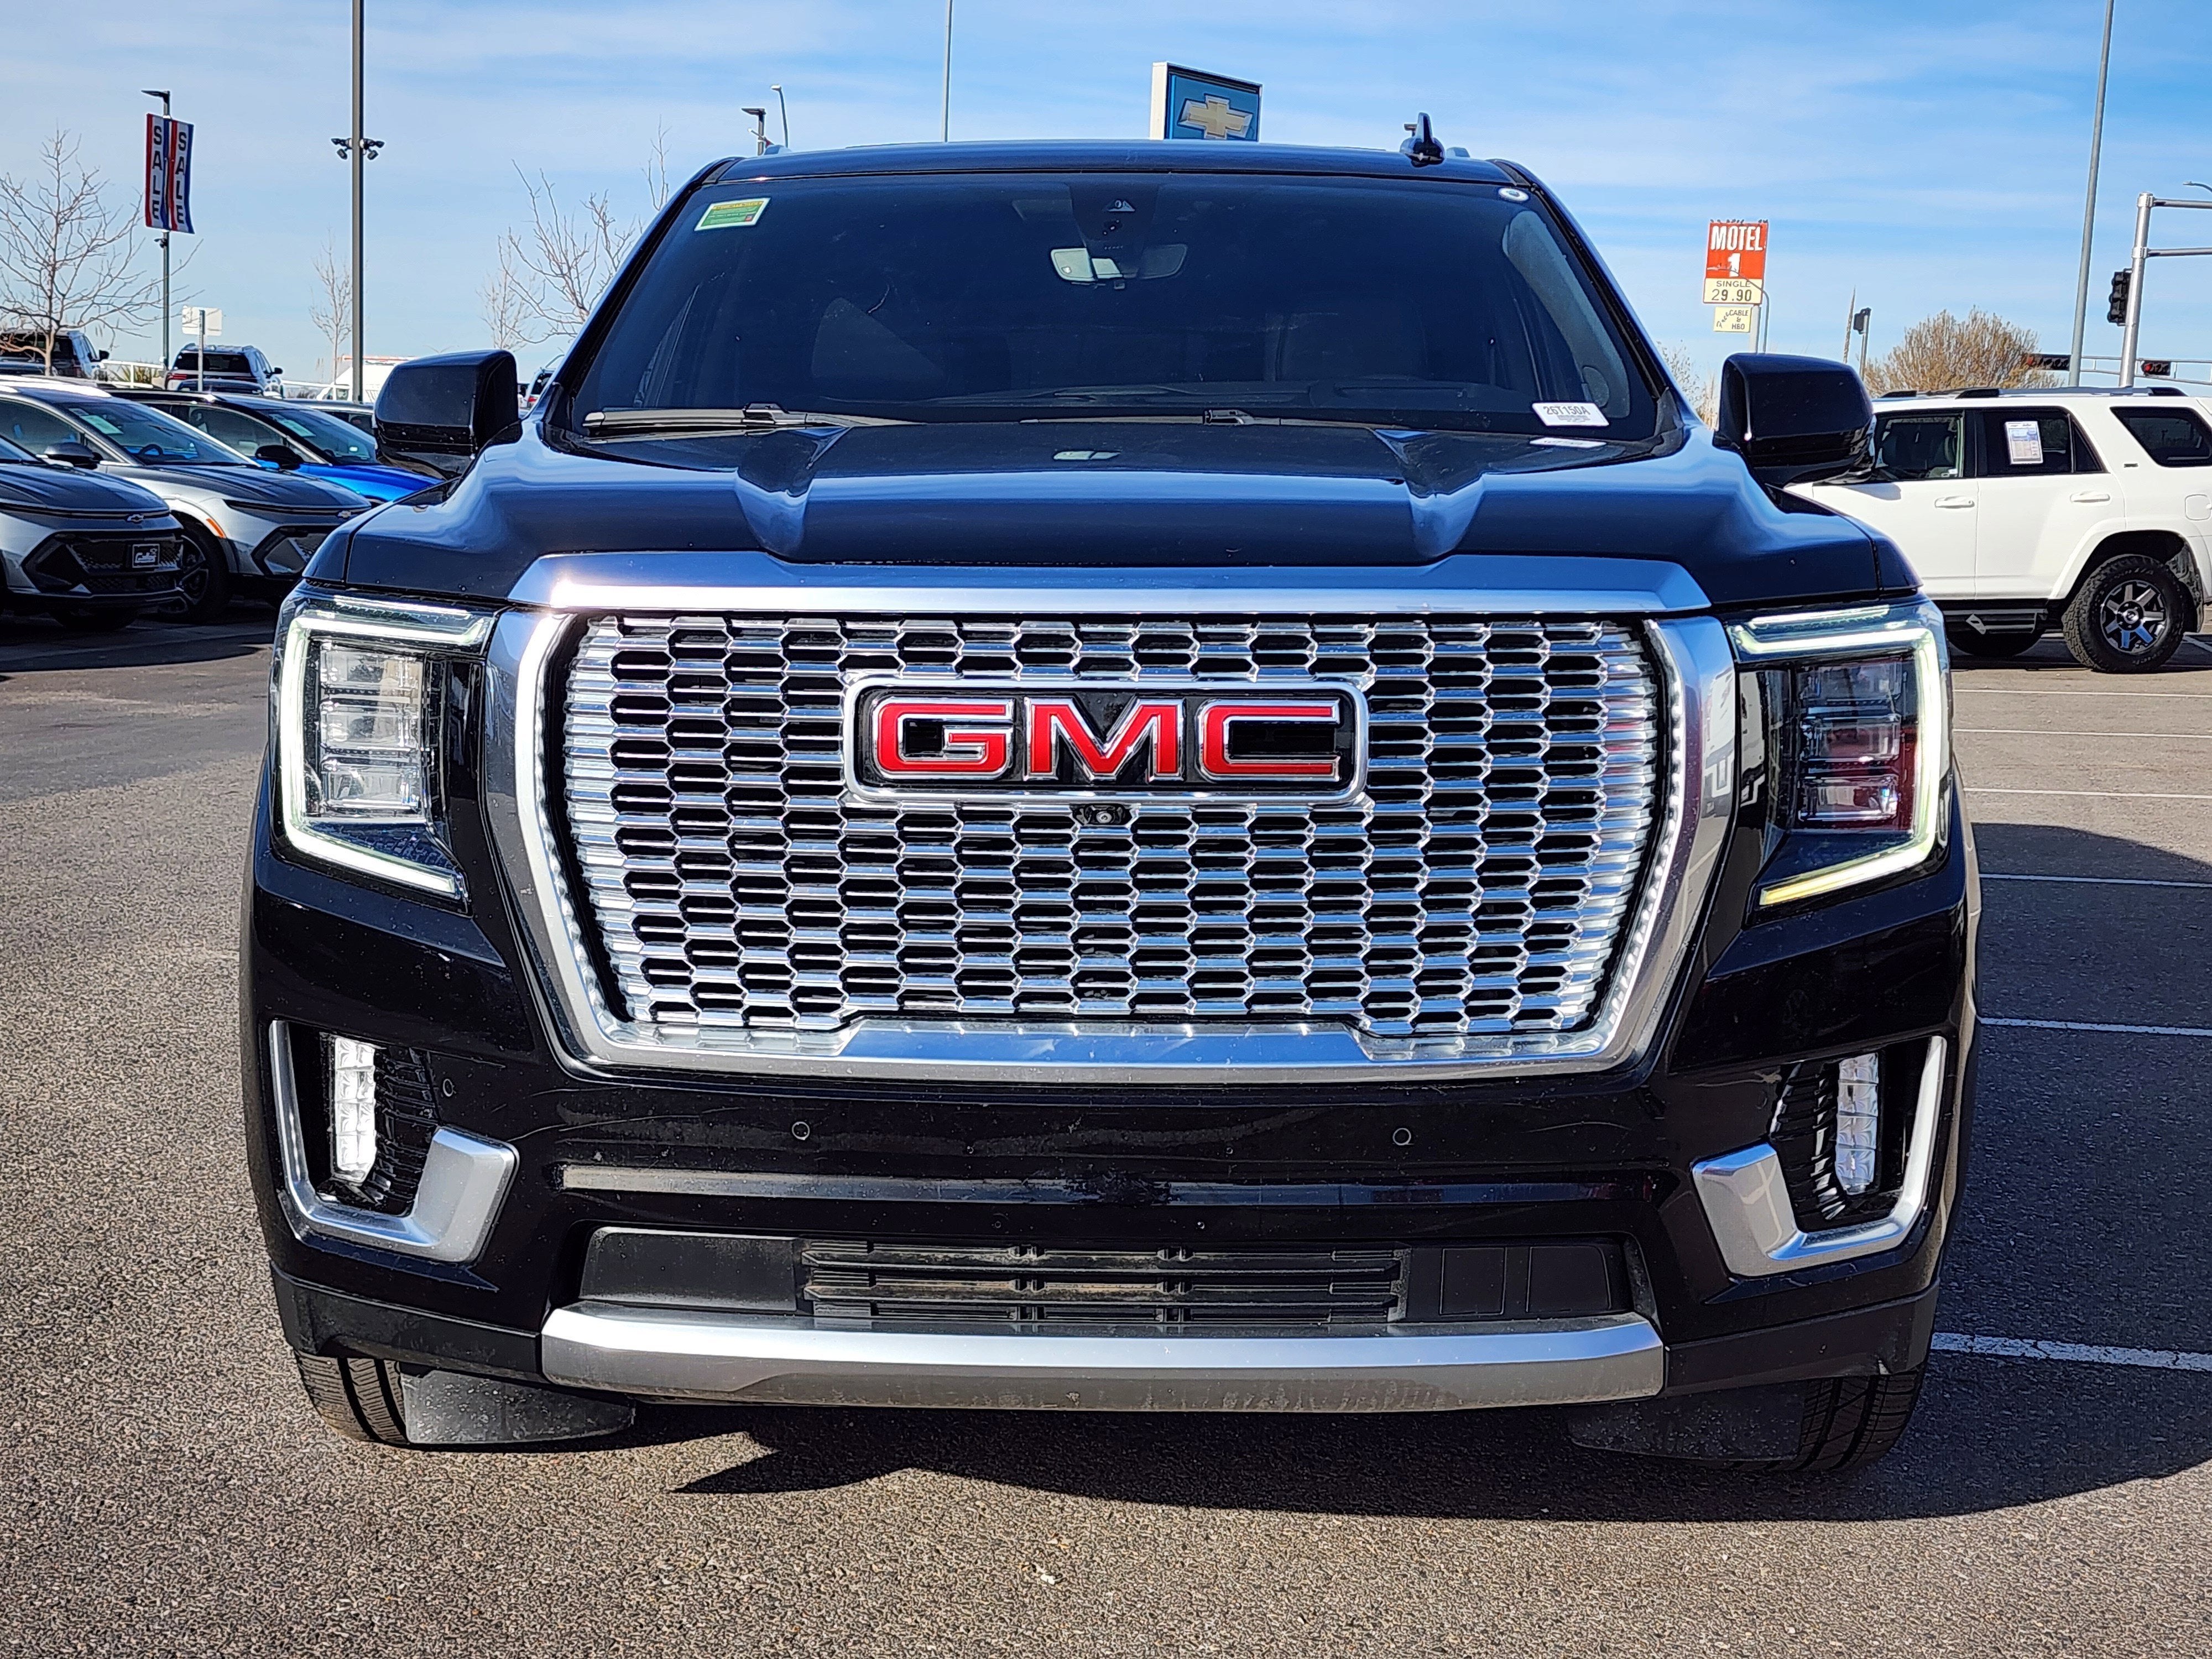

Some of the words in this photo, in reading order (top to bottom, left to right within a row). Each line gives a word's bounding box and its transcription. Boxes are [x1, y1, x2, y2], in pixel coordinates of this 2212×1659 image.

[152, 125, 163, 220] SALE
[175, 132, 186, 224] SALE
[1710, 225, 1763, 251] MOTEL
[872, 695, 1342, 783] GMC
